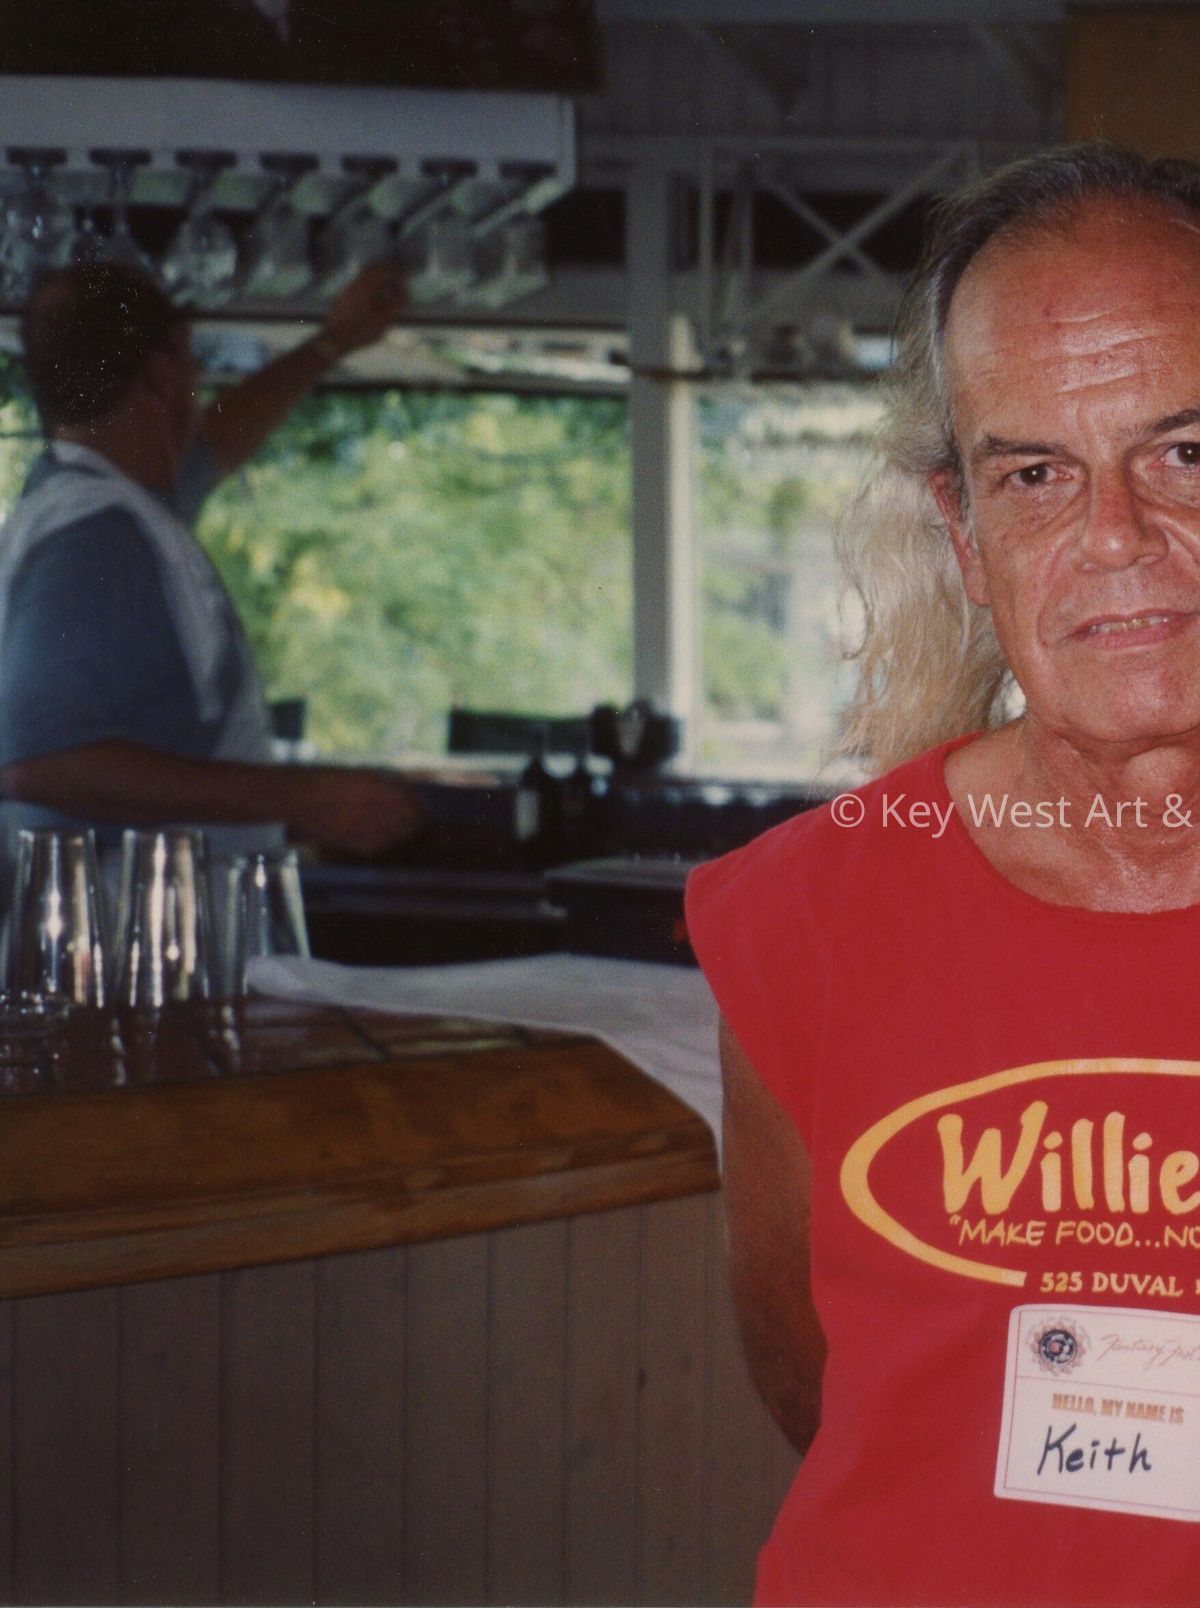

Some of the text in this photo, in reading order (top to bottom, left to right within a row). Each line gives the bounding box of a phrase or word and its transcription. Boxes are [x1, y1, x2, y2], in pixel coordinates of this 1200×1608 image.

[949, 1217, 1047, 1246] "MAKE
[1040, 1271, 1183, 1297] 525 DUVAL
[1051, 1392, 1184, 1425] HELLO, MY NAME IS
[1037, 1423, 1152, 1476] Keith
